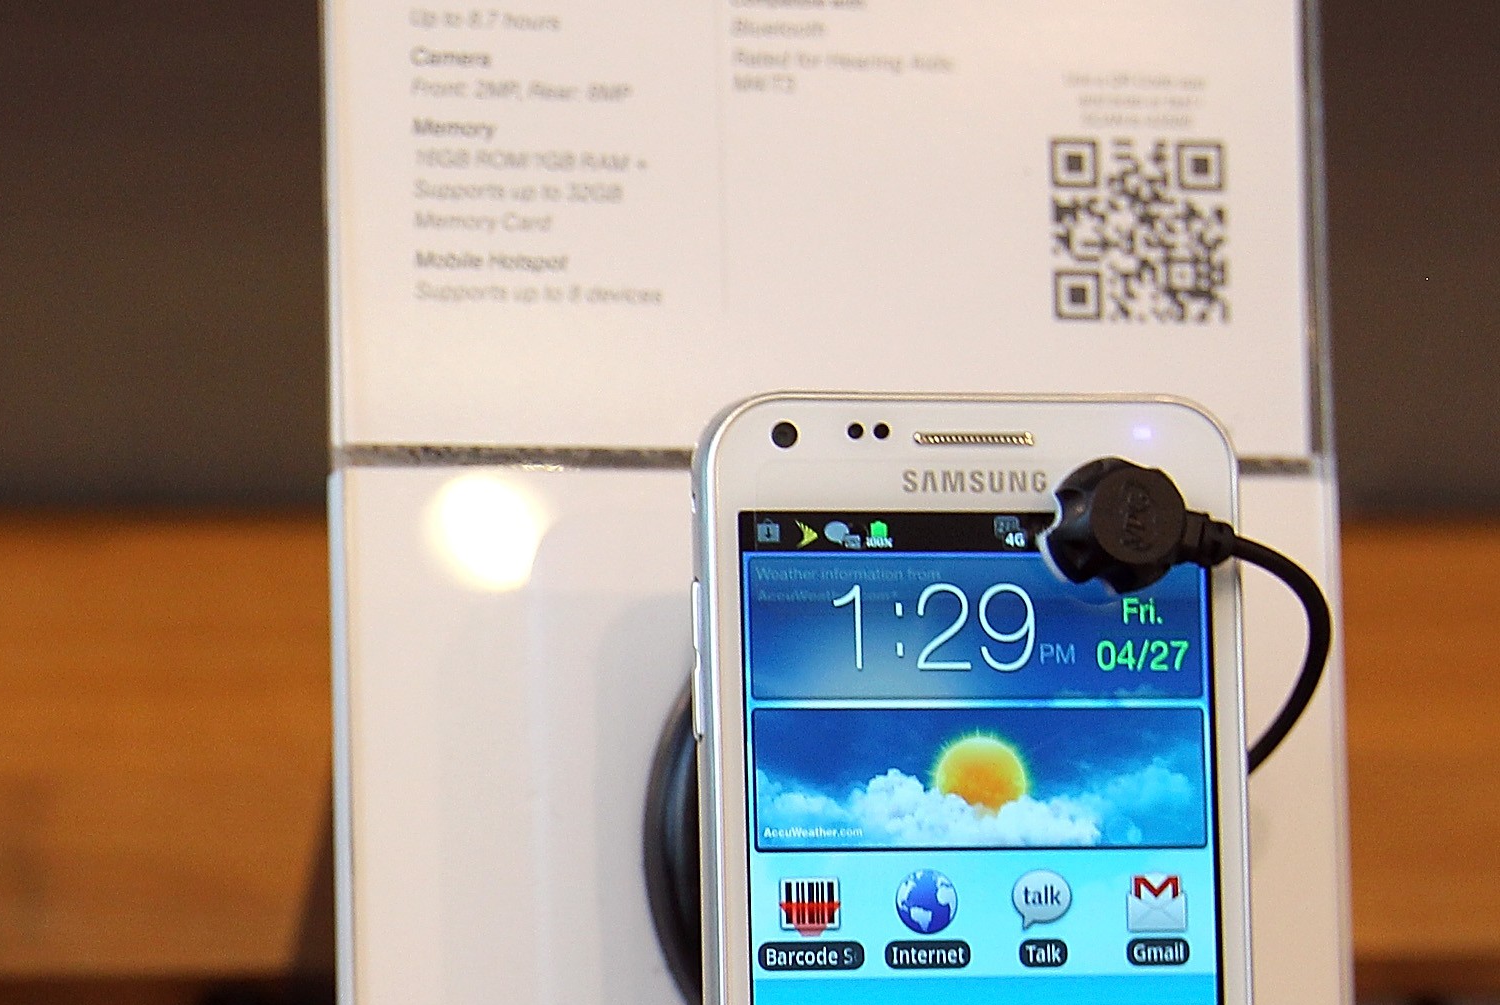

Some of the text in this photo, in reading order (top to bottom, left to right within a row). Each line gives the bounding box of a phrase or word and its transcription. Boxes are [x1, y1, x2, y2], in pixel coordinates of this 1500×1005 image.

[409, 46, 491, 68] Camera
[412, 118, 497, 140] Memory
[414, 180, 506, 202] Supports
[414, 211, 553, 233] Memory Card
[414, 251, 569, 274] Mobile Hotspot
[414, 282, 507, 303] Supports
[902, 469, 1049, 494] SAMSUNG
[1004, 532, 1027, 548] 4G
[1121, 597, 1164, 626] Fri.
[832, 582, 1077, 672] 1:29 PM
[1096, 640, 1189, 673] 04/27
[763, 824, 864, 841] AccuWeather.com
[1023, 882, 1062, 907] talk
[765, 946, 839, 966] Barcode
[892, 945, 965, 965] Internet
[1025, 943, 1062, 964] Talk
[1133, 942, 1186, 963] Gmail
